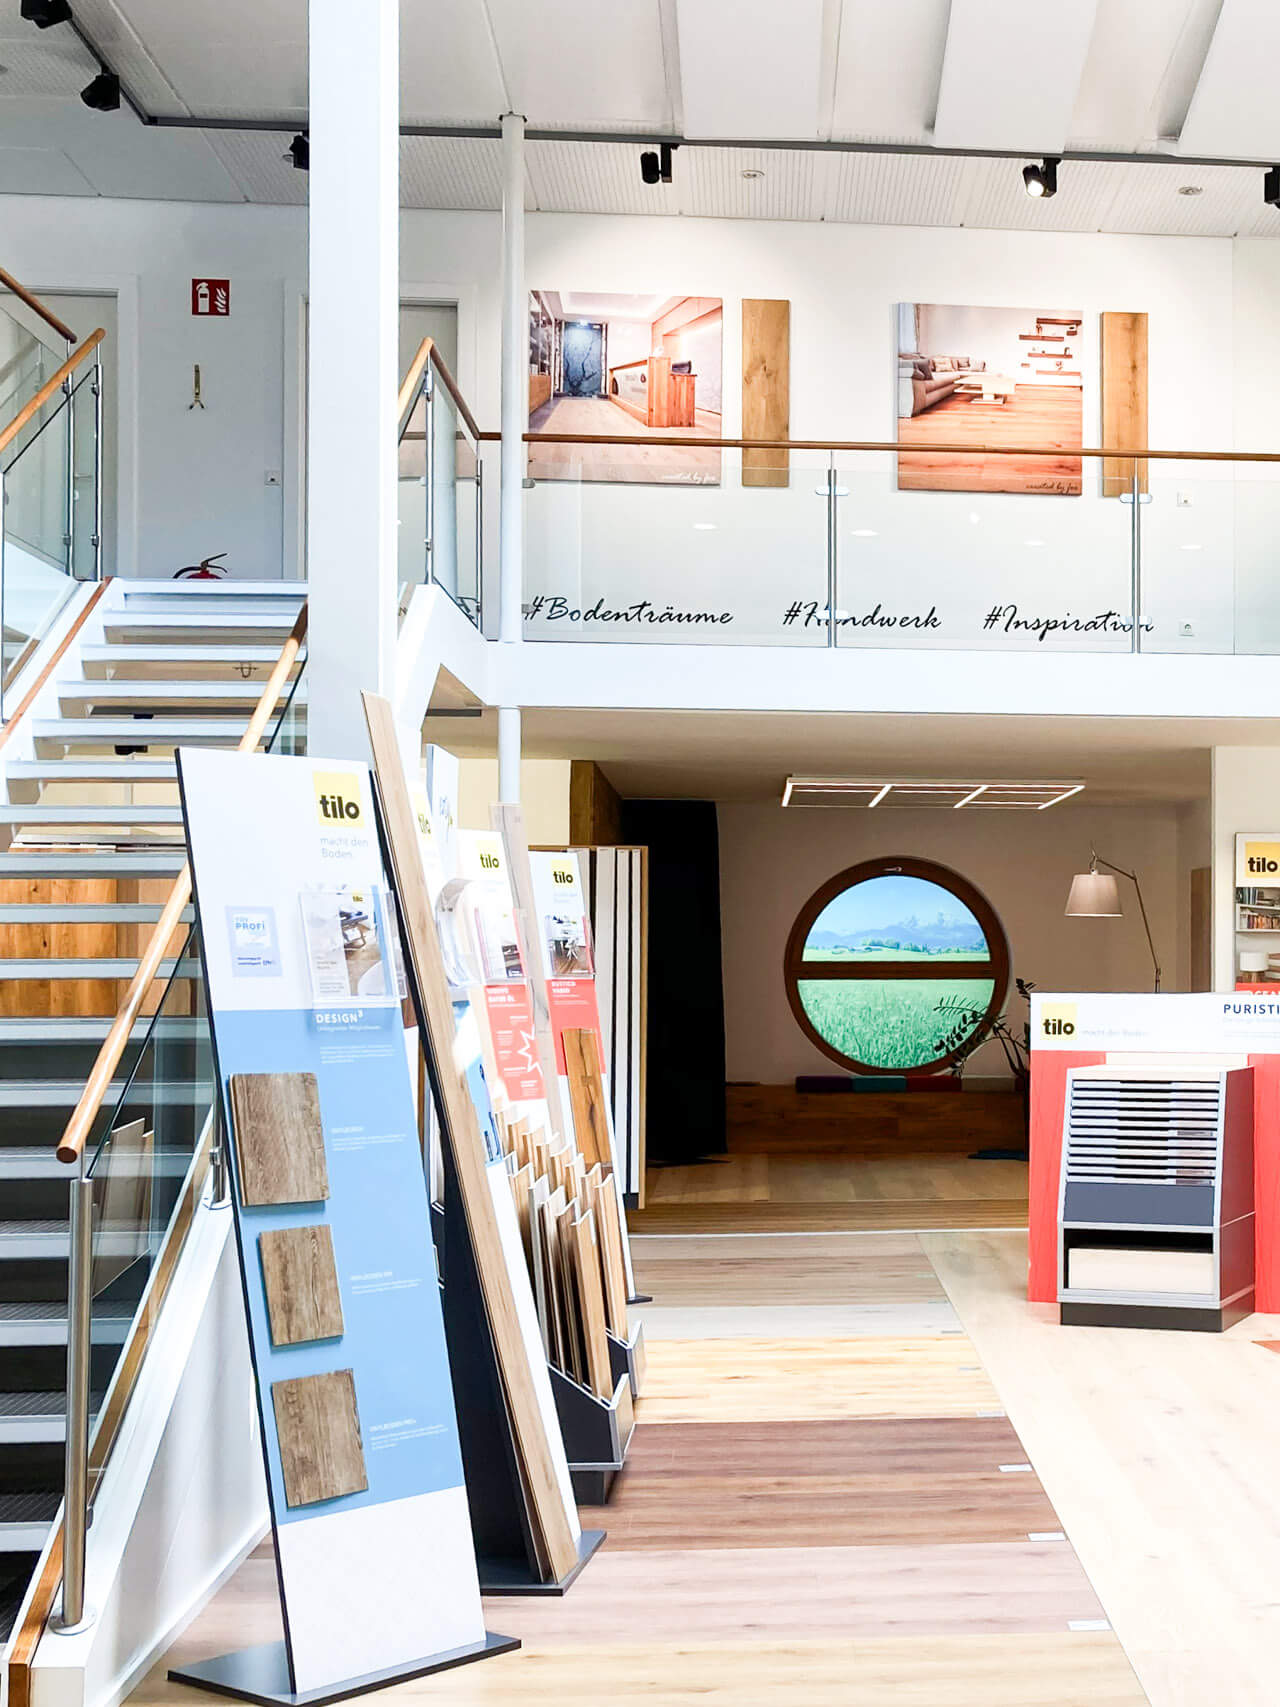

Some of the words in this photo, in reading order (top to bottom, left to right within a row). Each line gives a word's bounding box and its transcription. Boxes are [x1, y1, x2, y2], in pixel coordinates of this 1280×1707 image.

[524, 596, 735, 625] #Bodenträume
[319, 793, 361, 820] tilo
[480, 853, 500, 870] tilo
[1248, 857, 1278, 873] tilo
[553, 871, 573, 885] tilo
[1043, 1018, 1075, 1035] tilo
